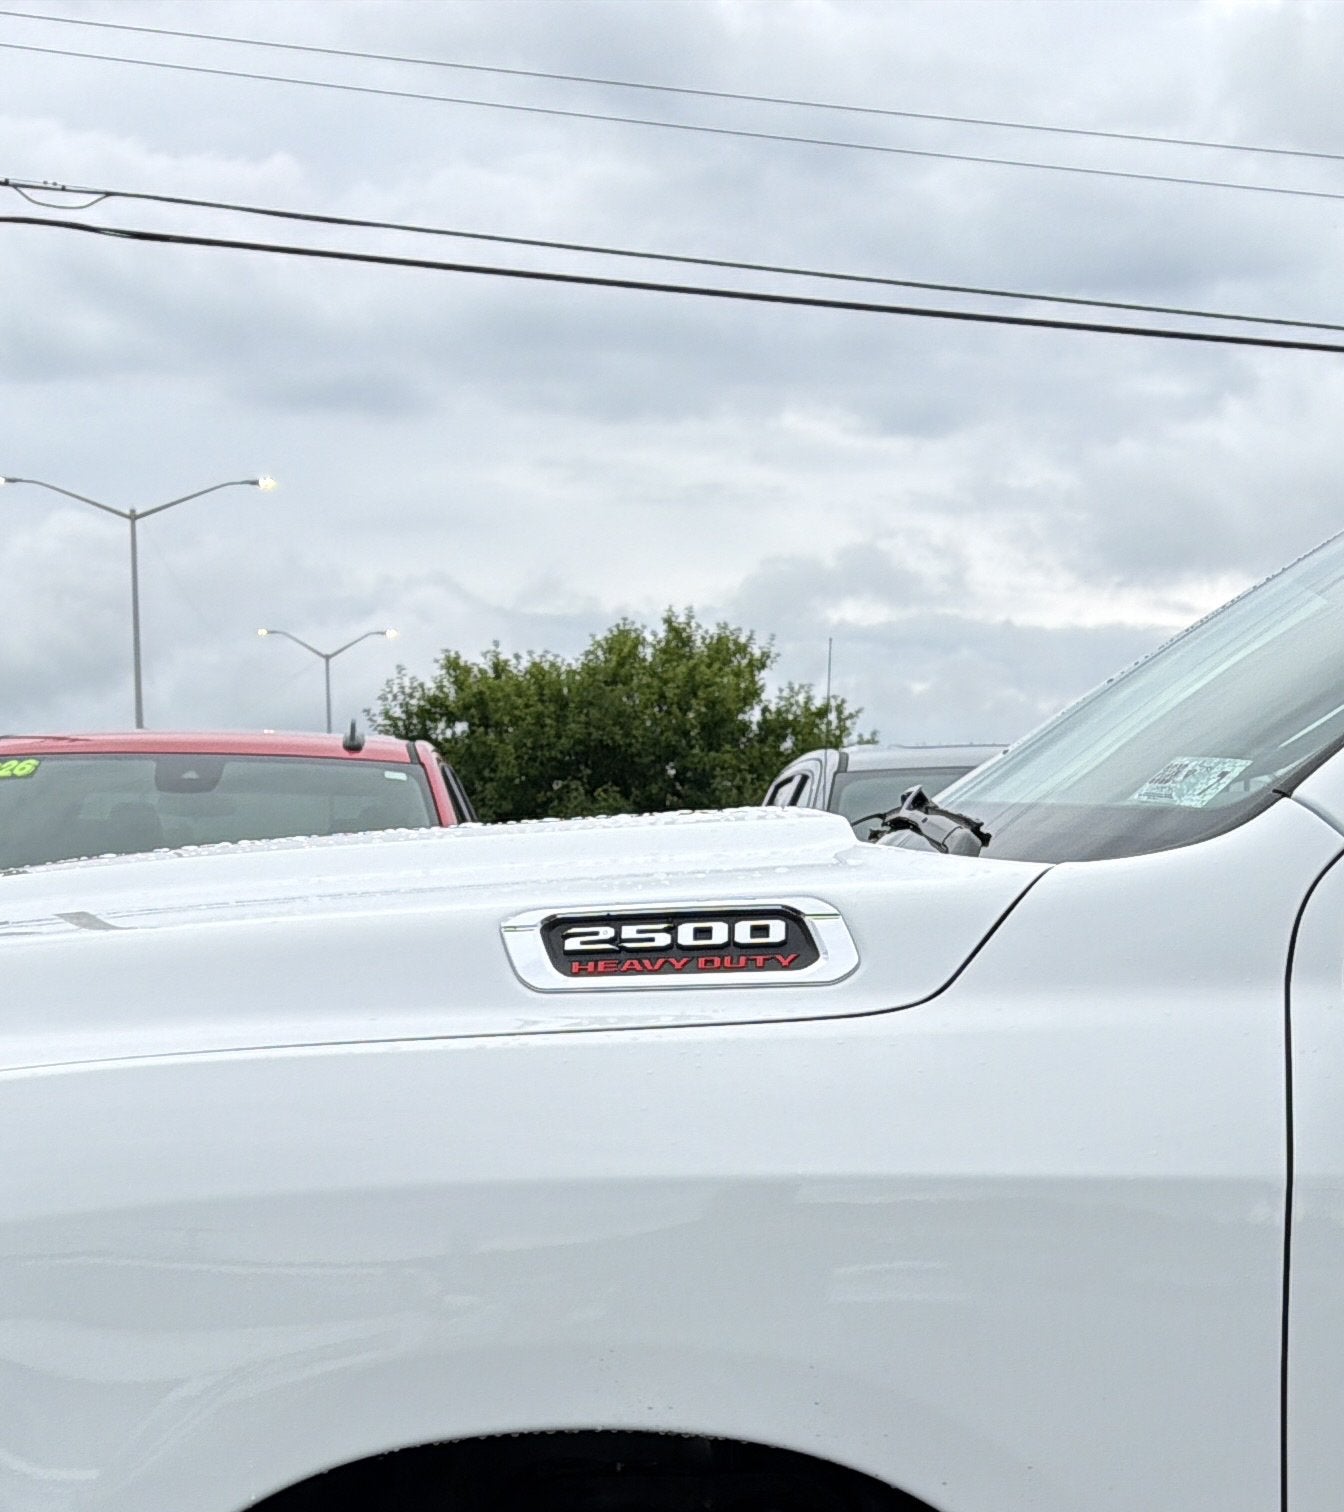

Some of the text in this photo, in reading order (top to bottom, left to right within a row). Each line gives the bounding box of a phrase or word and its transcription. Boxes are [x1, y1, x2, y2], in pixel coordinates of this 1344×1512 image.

[562, 919, 787, 955] 2500
[570, 953, 801, 974] HEAVY DUTY
